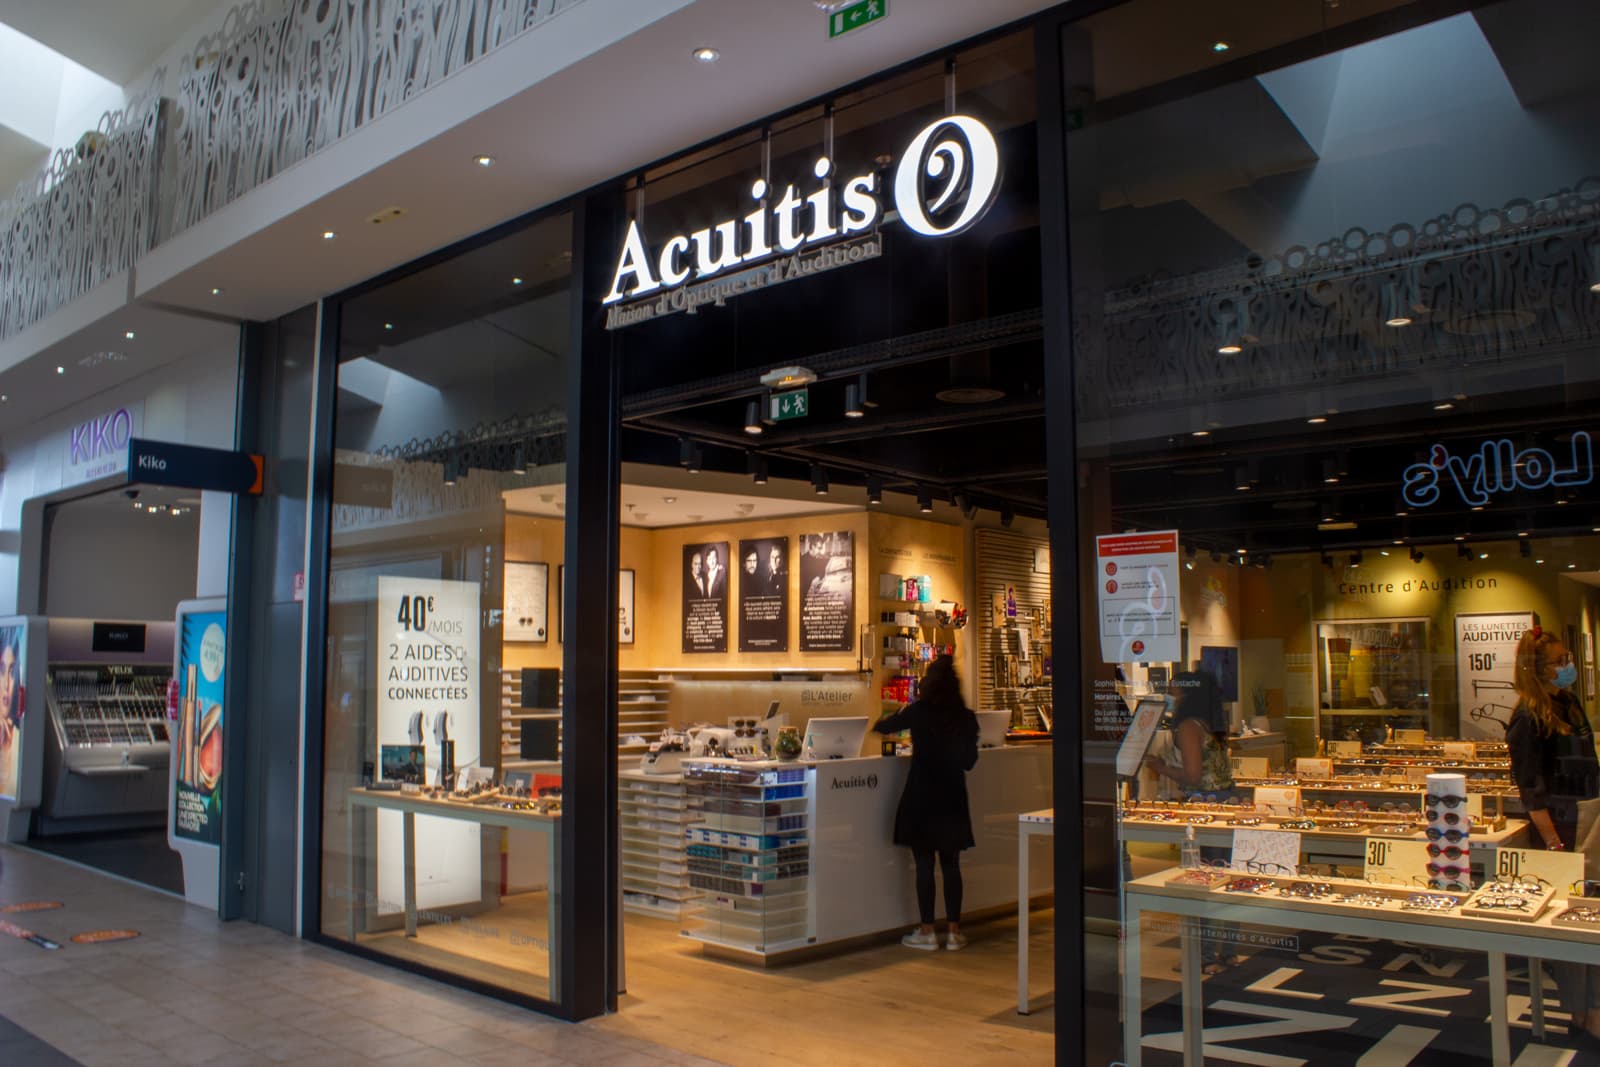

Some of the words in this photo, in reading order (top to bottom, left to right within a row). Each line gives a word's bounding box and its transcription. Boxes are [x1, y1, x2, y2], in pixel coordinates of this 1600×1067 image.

[602, 156, 880, 304] Acuitis
[605, 302, 651, 329] Maison
[655, 279, 743, 314] d'Optique
[768, 240, 878, 283] d'Audition
[70, 408, 133, 465] KIKO
[139, 455, 167, 470] Kiko
[1338, 582, 1394, 595] Centre
[1402, 577, 1498, 592] d'Audition
[1463, 623, 1479, 632] LES
[1481, 622, 1528, 632] LUNETTES
[389, 643, 399, 660] 2
[405, 644, 453, 661] AIDES
[388, 665, 468, 682] AUDITIVES
[811, 689, 852, 701] L'Atelier
